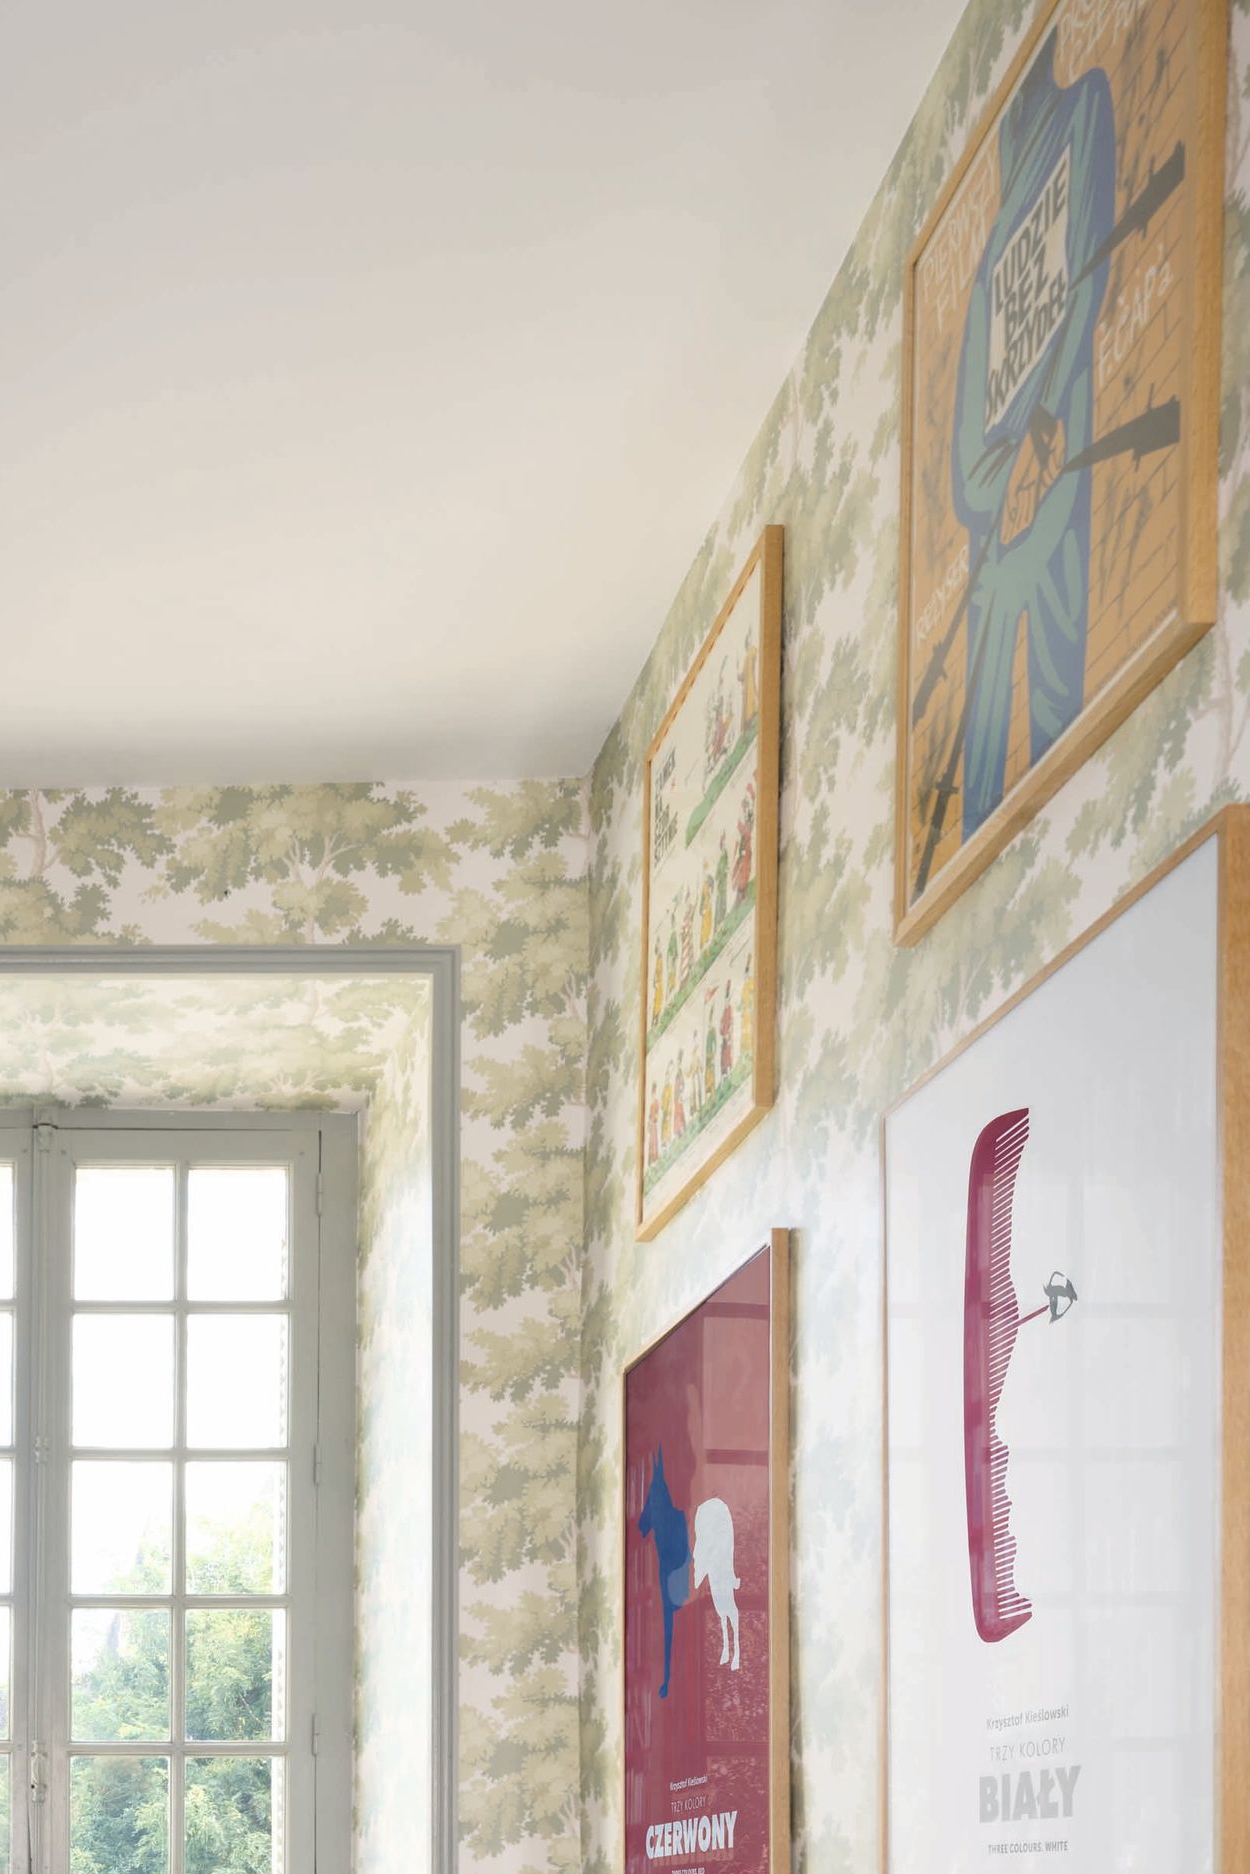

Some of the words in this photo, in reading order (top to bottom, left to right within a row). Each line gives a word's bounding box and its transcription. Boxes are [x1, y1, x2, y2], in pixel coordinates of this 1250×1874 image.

[995, 158, 1067, 317] LUDZIE
[1005, 241, 1049, 351] BEZ
[990, 1744, 1015, 1762] TRZY
[1019, 1736, 1066, 1759] KOLORY
[979, 1765, 1082, 1824] BIAŁY
[645, 1811, 738, 1859] CZERWONY
[988, 1844, 1008, 1855] THREE
[1044, 1841, 1069, 1852] WHITE
